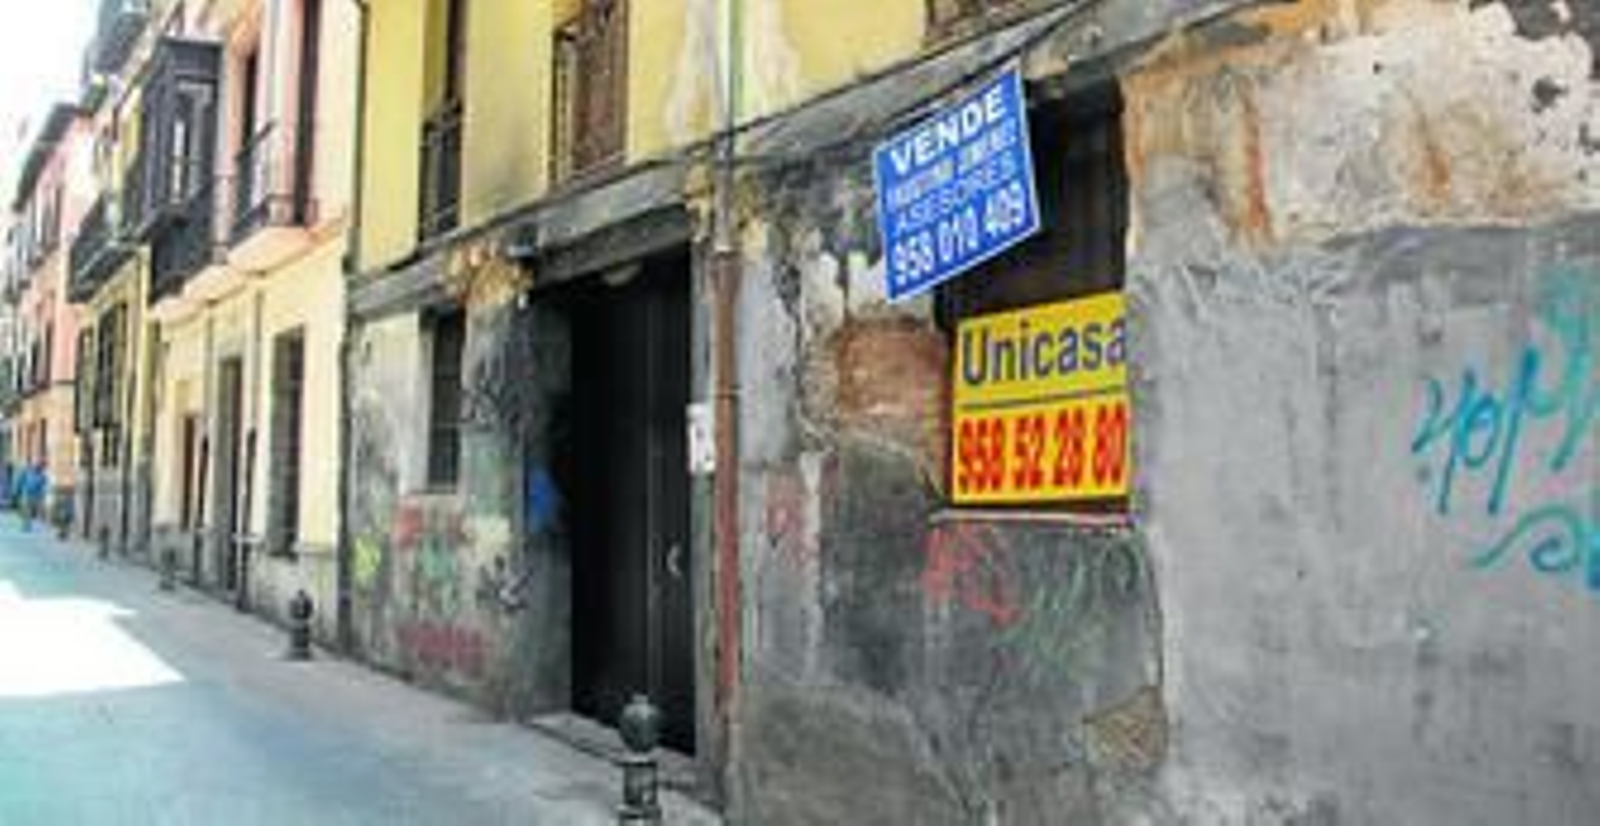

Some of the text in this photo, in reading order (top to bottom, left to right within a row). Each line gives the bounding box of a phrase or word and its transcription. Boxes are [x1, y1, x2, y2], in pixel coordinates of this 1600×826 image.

[890, 84, 1006, 174] VENDE
[892, 229, 934, 286] 958
[938, 205, 979, 262] 010
[963, 317, 1126, 385] Unicasa
[958, 402, 1125, 493] 958 52 28 80
